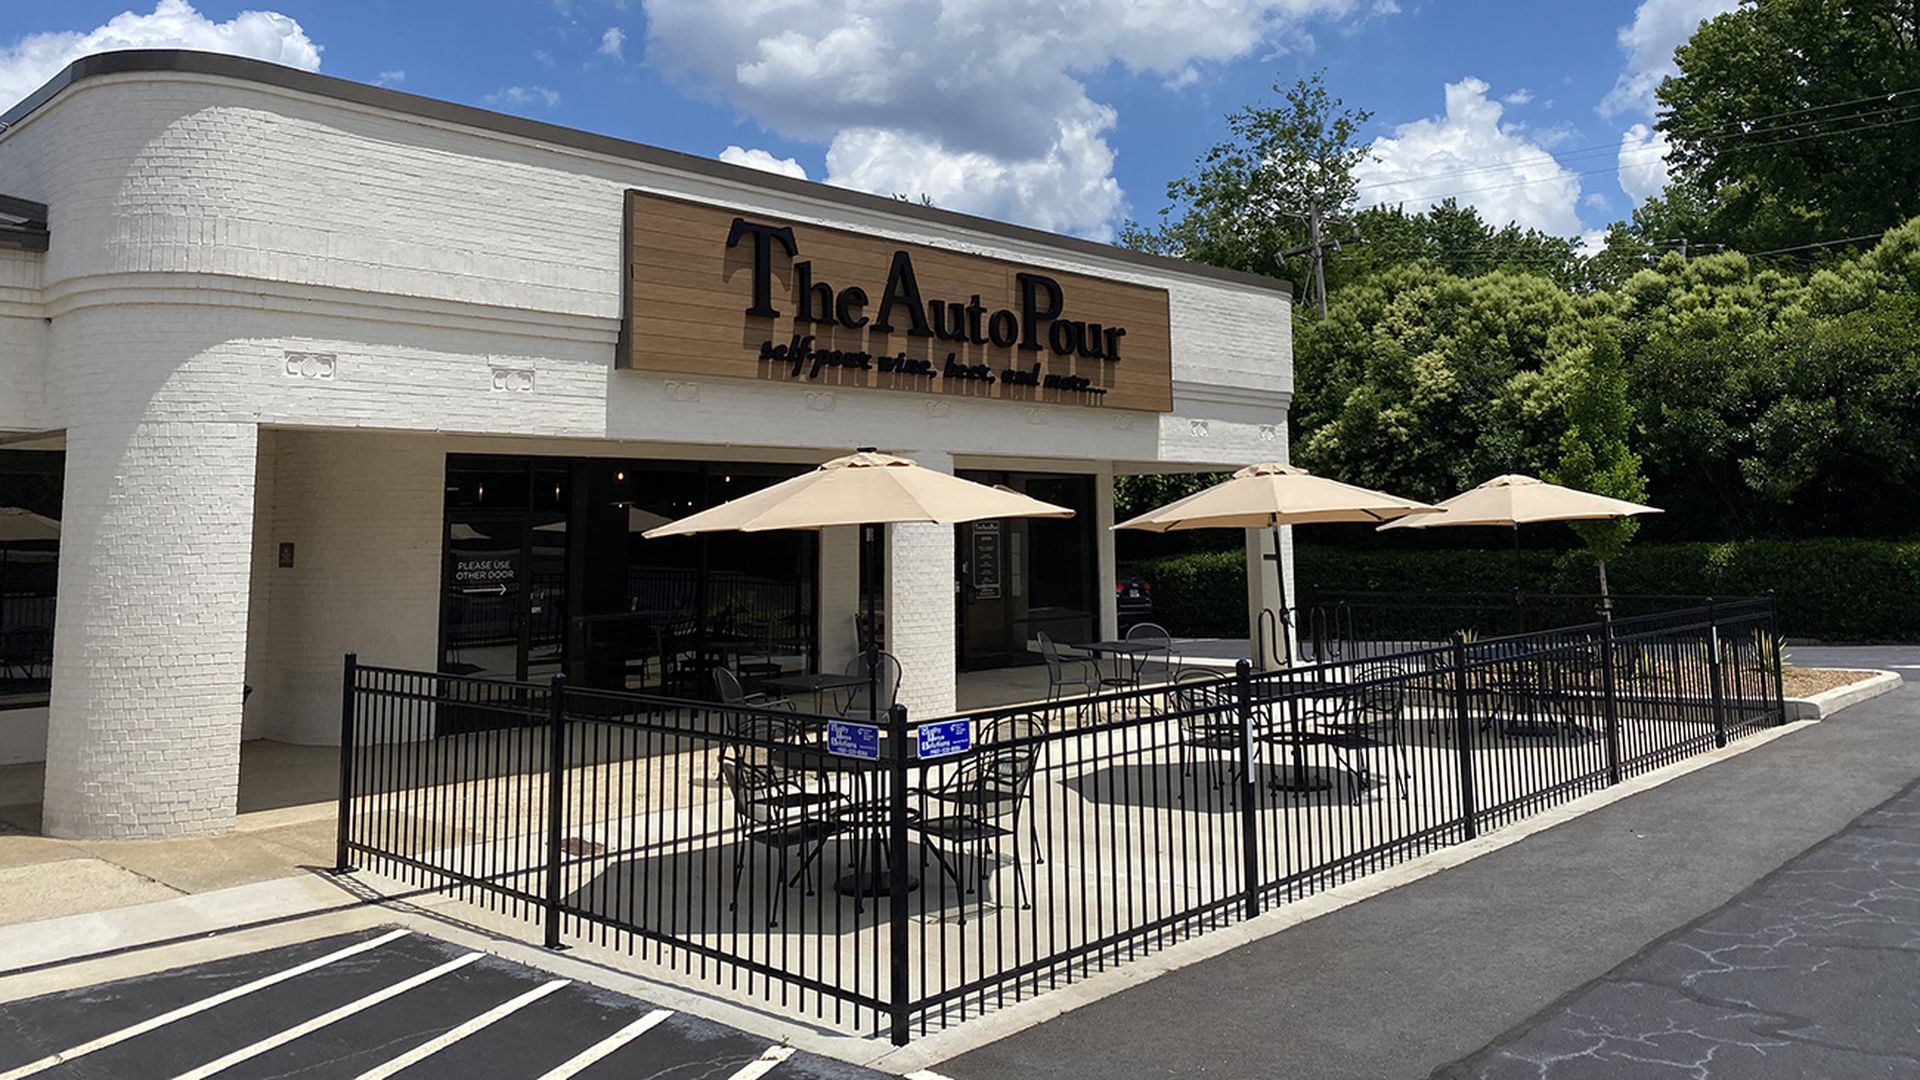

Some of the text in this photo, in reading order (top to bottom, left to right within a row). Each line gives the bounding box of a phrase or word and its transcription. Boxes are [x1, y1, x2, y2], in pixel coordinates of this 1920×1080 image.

[1001, 362, 1041, 386] and
[457, 560, 511, 570] PLEASE USE
[456, 570, 514, 580] OTHER DOOR
